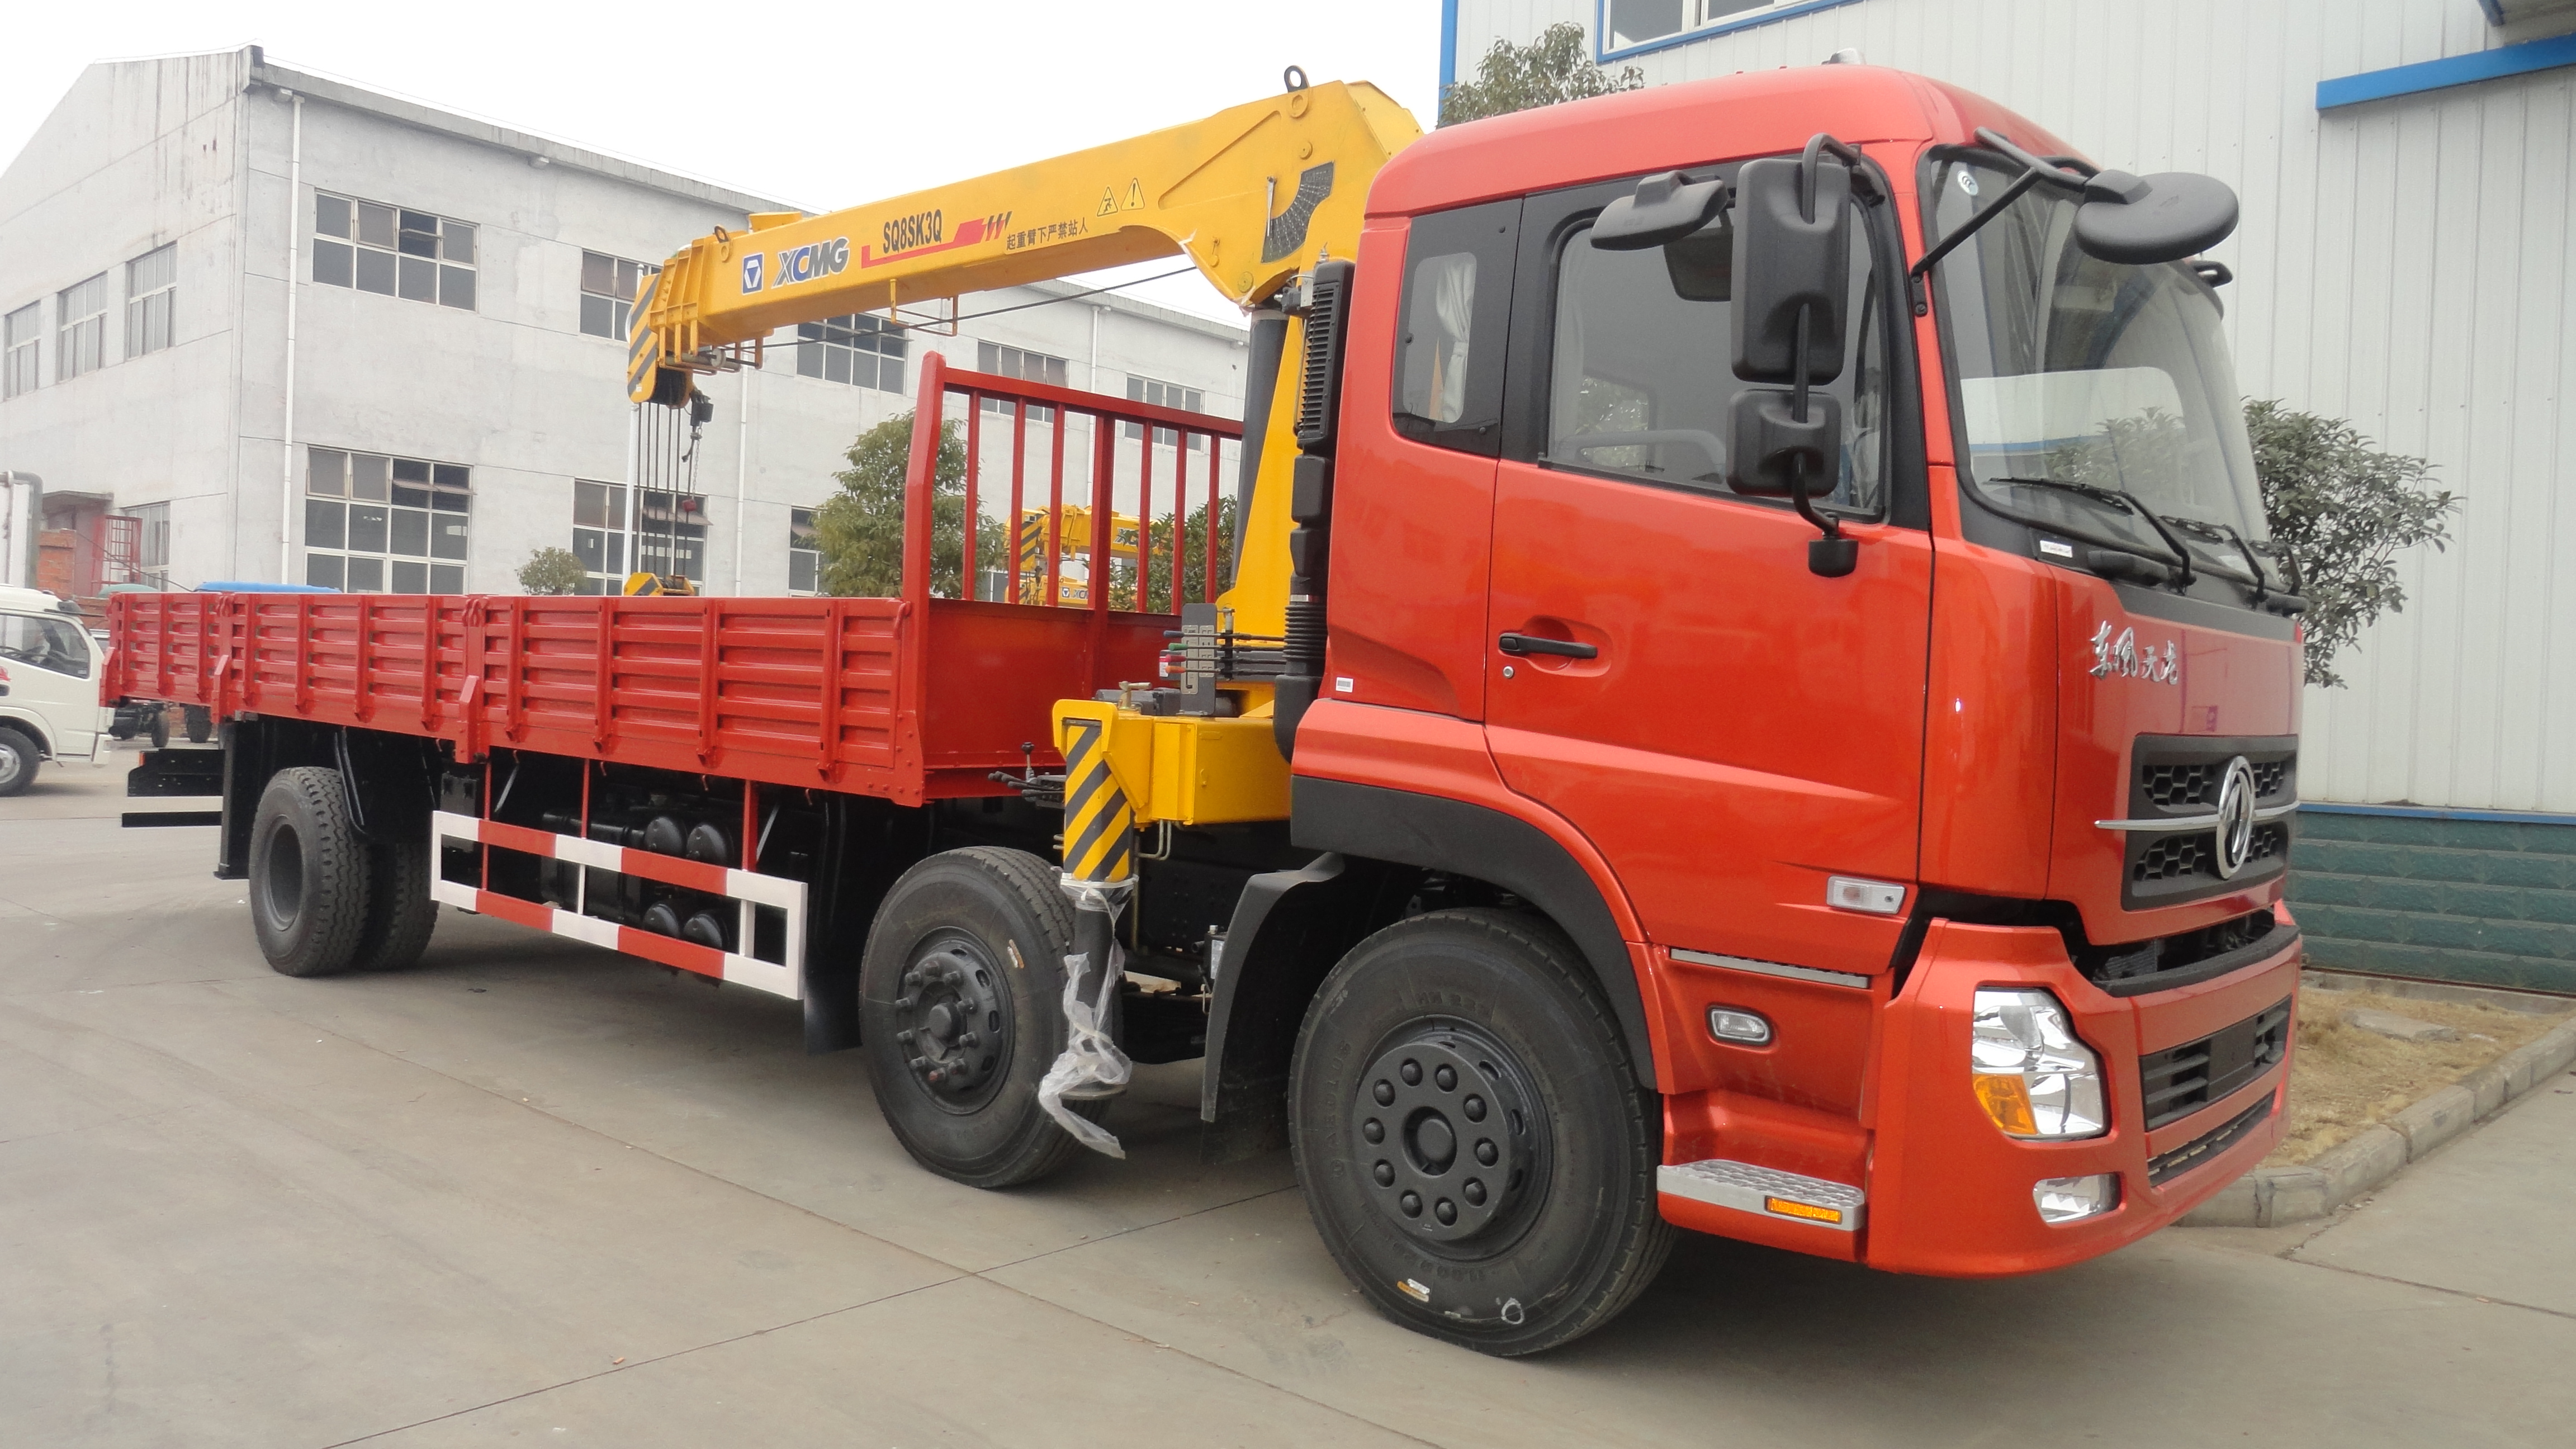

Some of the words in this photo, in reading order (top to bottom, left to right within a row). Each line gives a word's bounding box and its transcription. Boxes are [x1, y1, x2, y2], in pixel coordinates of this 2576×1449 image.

[883, 209, 943, 255] SQ8SK3Q
[1006, 216, 1089, 250] 起重臂下严禁站人
[771, 236, 850, 289] XCMG
